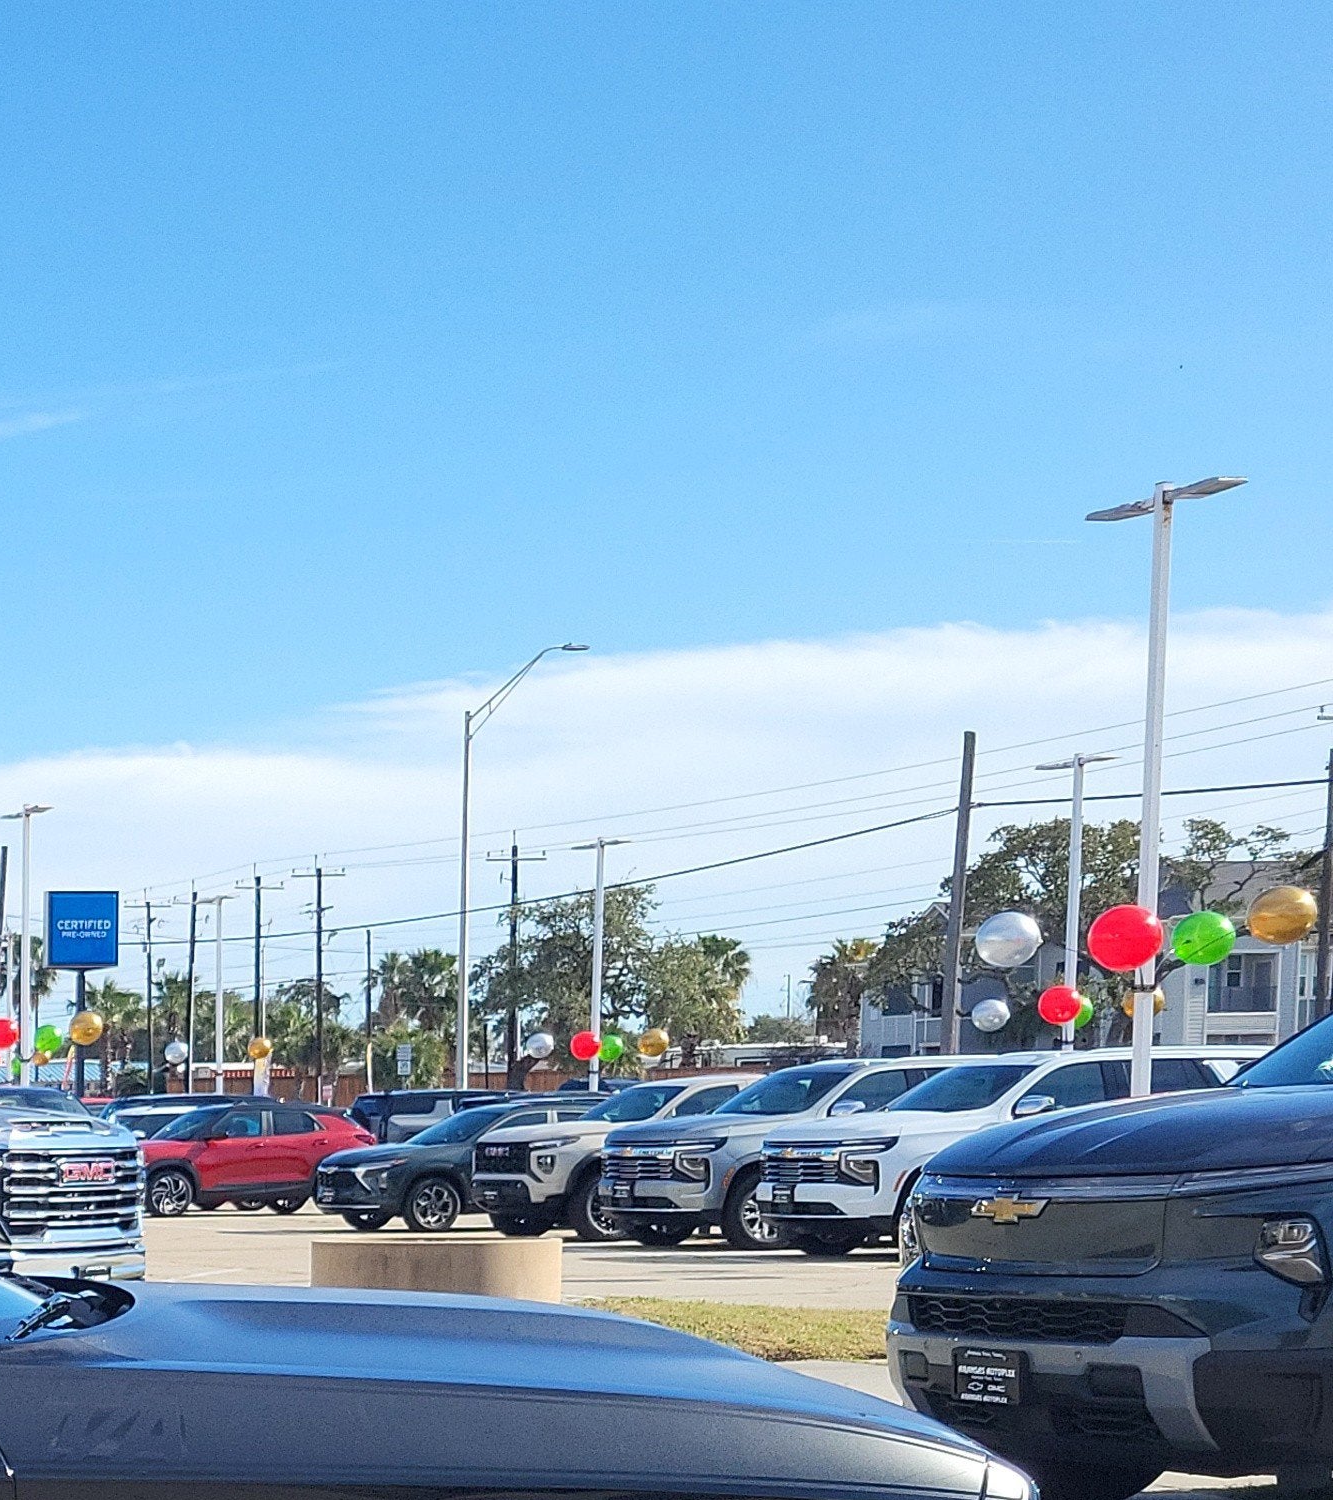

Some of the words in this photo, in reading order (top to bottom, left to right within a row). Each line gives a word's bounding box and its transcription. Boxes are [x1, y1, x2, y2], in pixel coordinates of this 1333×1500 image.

[56, 919, 111, 930] CERTIFIED
[61, 931, 107, 939] PRE-OWNED
[63, 1162, 115, 1181] GMC
